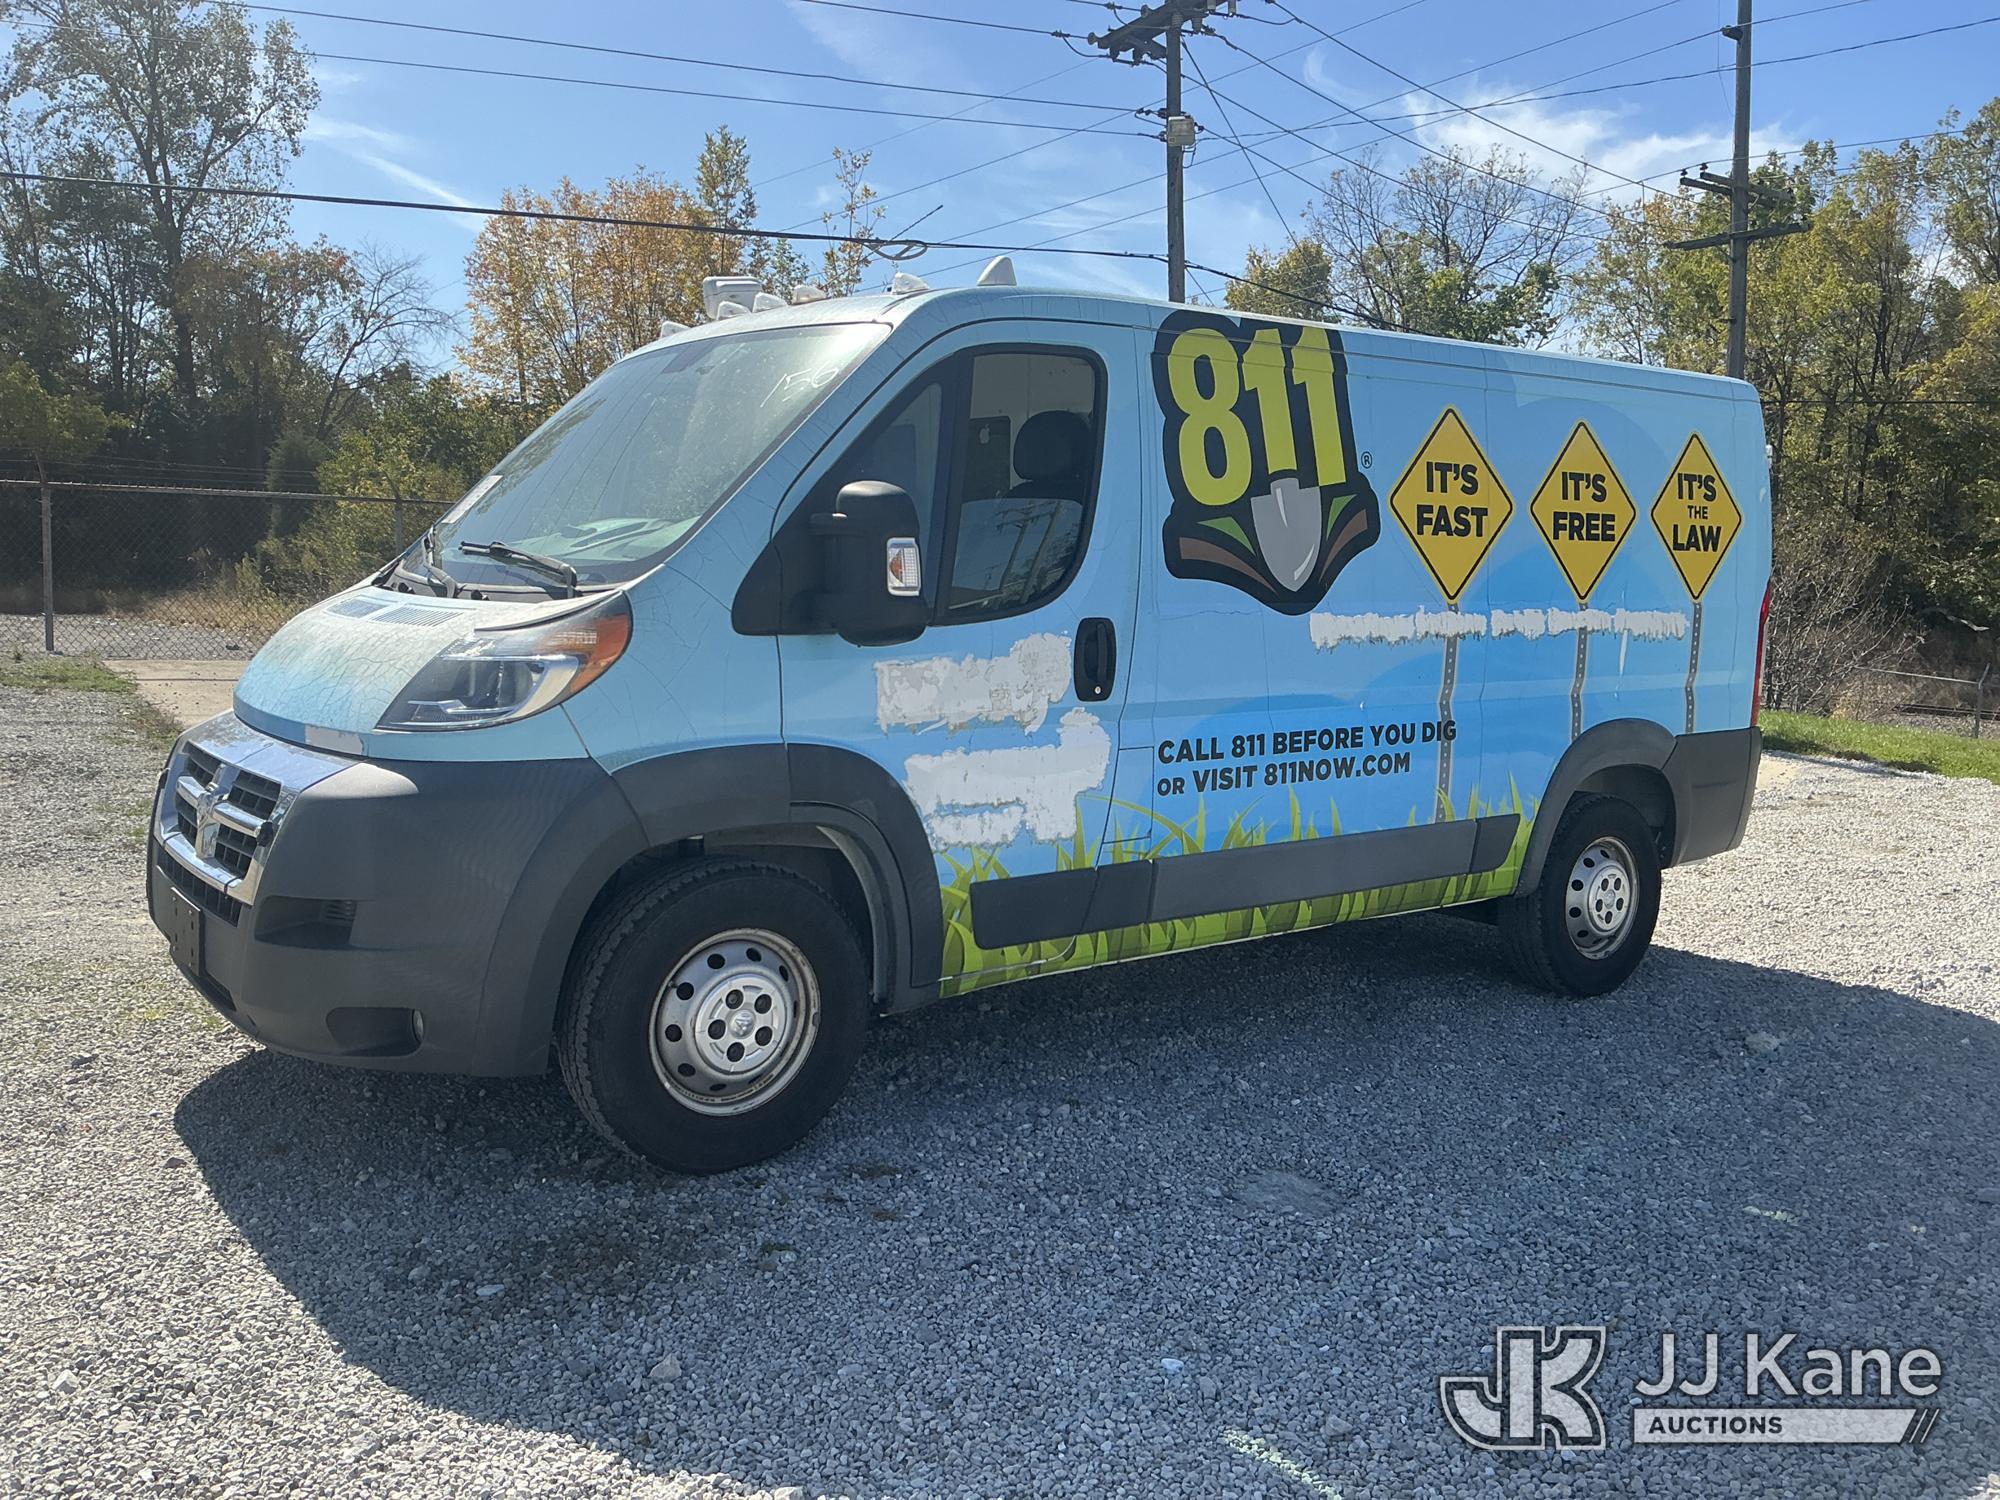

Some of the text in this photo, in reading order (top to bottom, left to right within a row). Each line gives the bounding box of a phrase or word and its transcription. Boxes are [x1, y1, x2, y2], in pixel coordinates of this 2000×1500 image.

[1167, 326, 1347, 506] 811
[1426, 461, 1478, 496] IT'S
[1561, 471, 1607, 503] IT'S
[1677, 473, 1717, 502] IT'S
[1416, 504, 1488, 537] FAST
[1553, 511, 1616, 542] FREE
[1687, 505, 1709, 520] THE
[1672, 524, 1722, 552] LAW
[1158, 720, 1457, 764] CALL 811 BEFORE YOU DIG
[1157, 752, 1411, 796] OR VISIT 811NOW.COM
